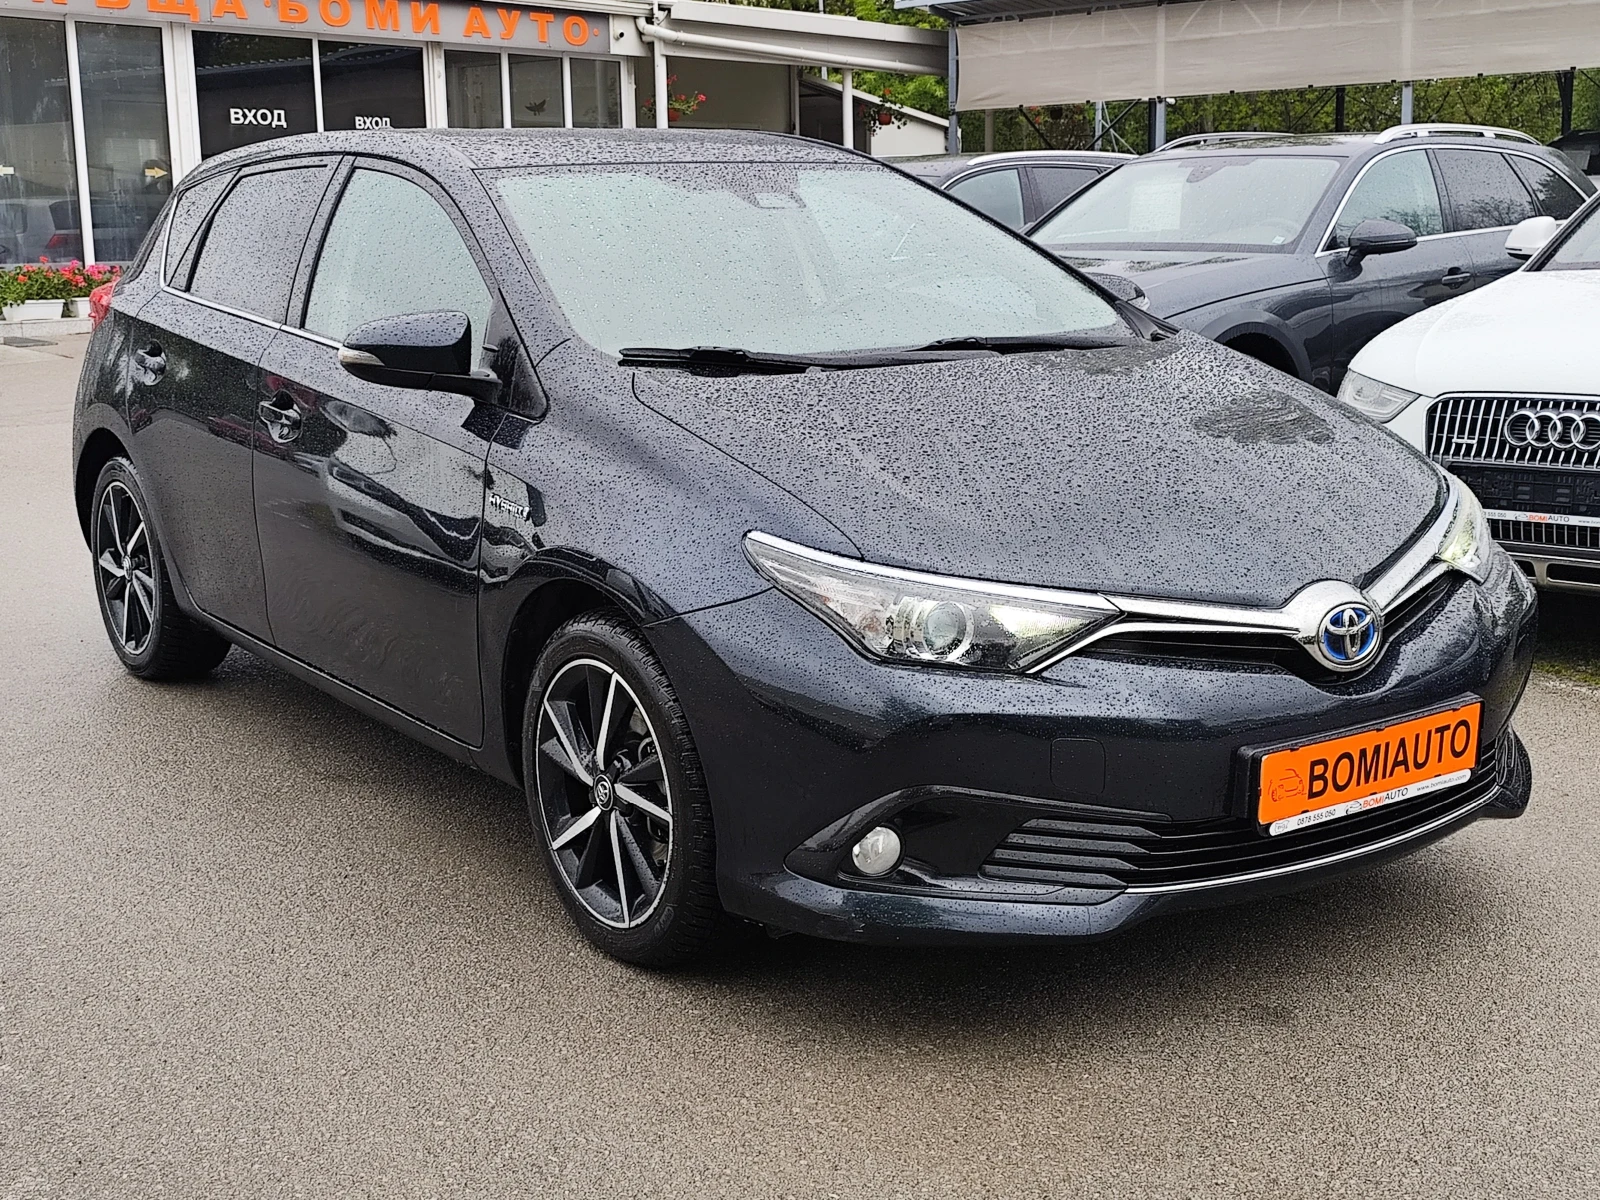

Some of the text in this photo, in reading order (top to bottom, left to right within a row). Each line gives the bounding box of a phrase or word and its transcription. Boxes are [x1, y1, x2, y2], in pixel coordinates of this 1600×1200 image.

[462, 7, 590, 46] АУТО
[229, 108, 287, 129] ВХОД
[1528, 514, 1570, 523] BOMIAUTO
[1307, 719, 1471, 800] BOMIAUTO
[1362, 787, 1409, 809] BOMIAUTO
